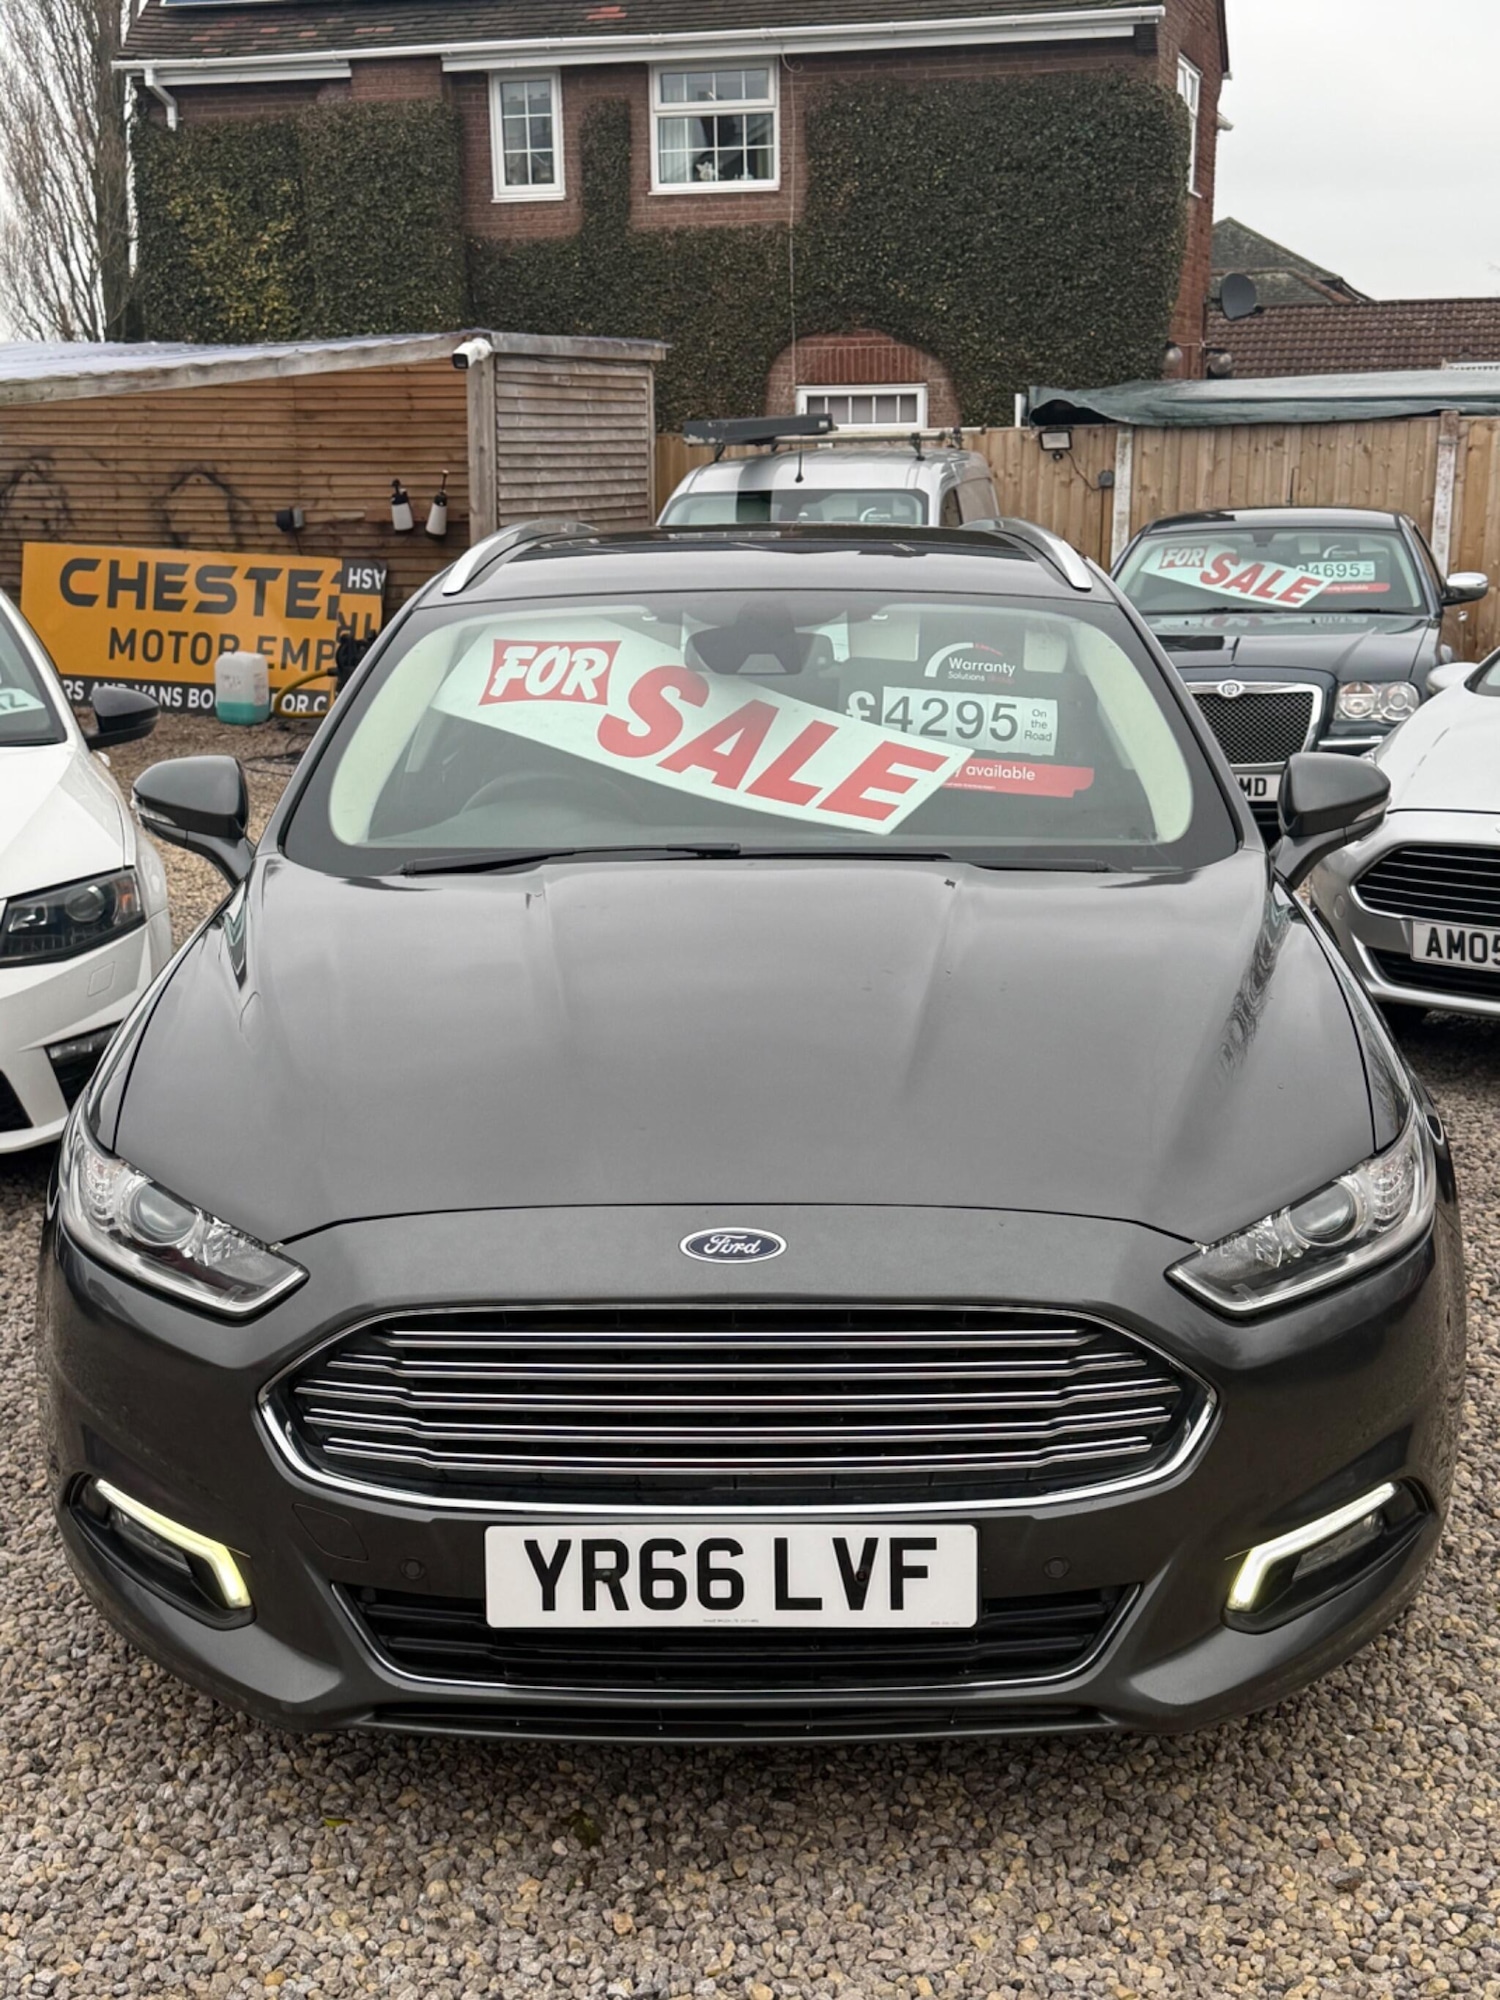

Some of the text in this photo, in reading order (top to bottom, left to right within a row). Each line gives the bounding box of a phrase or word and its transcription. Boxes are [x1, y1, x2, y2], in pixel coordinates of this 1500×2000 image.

[1162, 547, 1323, 603] FOR SALE
[947, 671, 985, 682] Solutions
[948, 657, 1016, 677] Warranty
[846, 690, 1019, 742] £4295
[1031, 718, 1048, 729] the
[1032, 708, 1047, 719] On
[492, 645, 950, 821] FOR SALE
[1024, 730, 1053, 742] Road
[966, 763, 1036, 781] available
[703, 1234, 761, 1254] Ford
[523, 1537, 937, 1612] YR66 LVF
